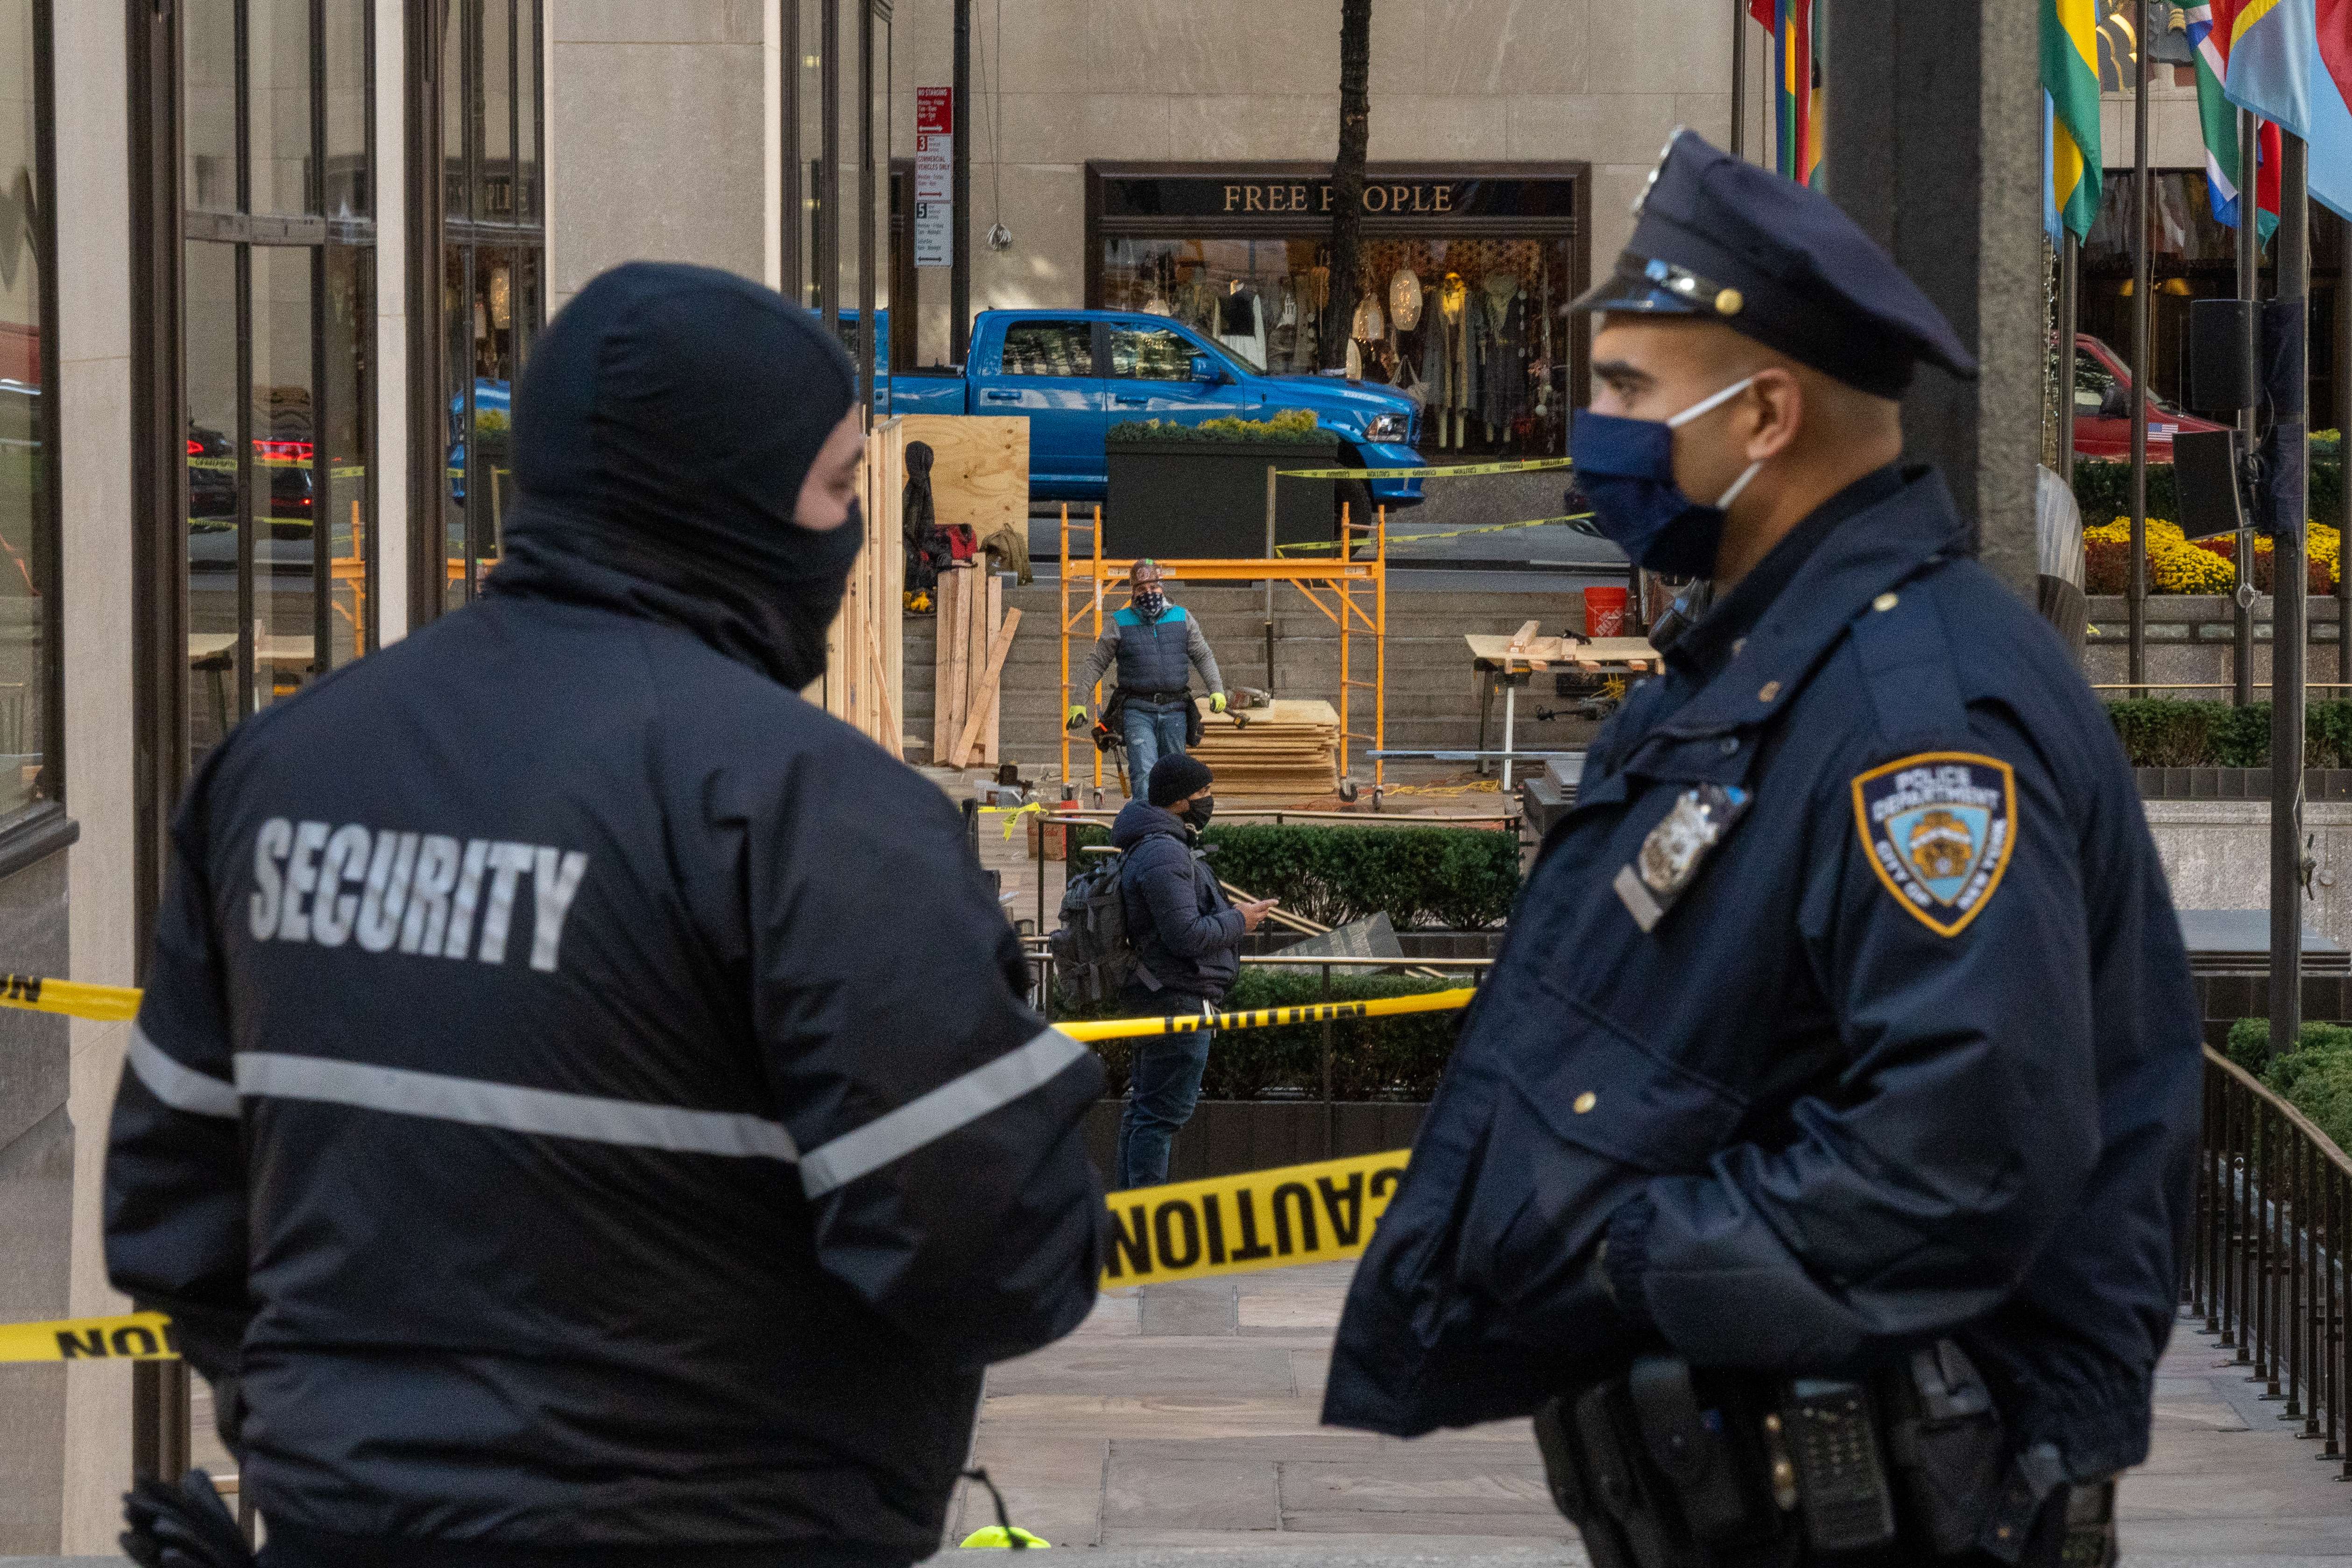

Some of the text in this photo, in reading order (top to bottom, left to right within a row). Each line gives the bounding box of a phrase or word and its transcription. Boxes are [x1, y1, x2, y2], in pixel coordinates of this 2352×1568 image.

[919, 136, 925, 150] 3
[918, 204, 925, 218] 5
[1223, 185, 1453, 212] FREE POPLE
[1895, 766, 1971, 792] POLICE
[1872, 787, 2000, 822] DEPARTMENT
[249, 816, 589, 972] SECURITY
